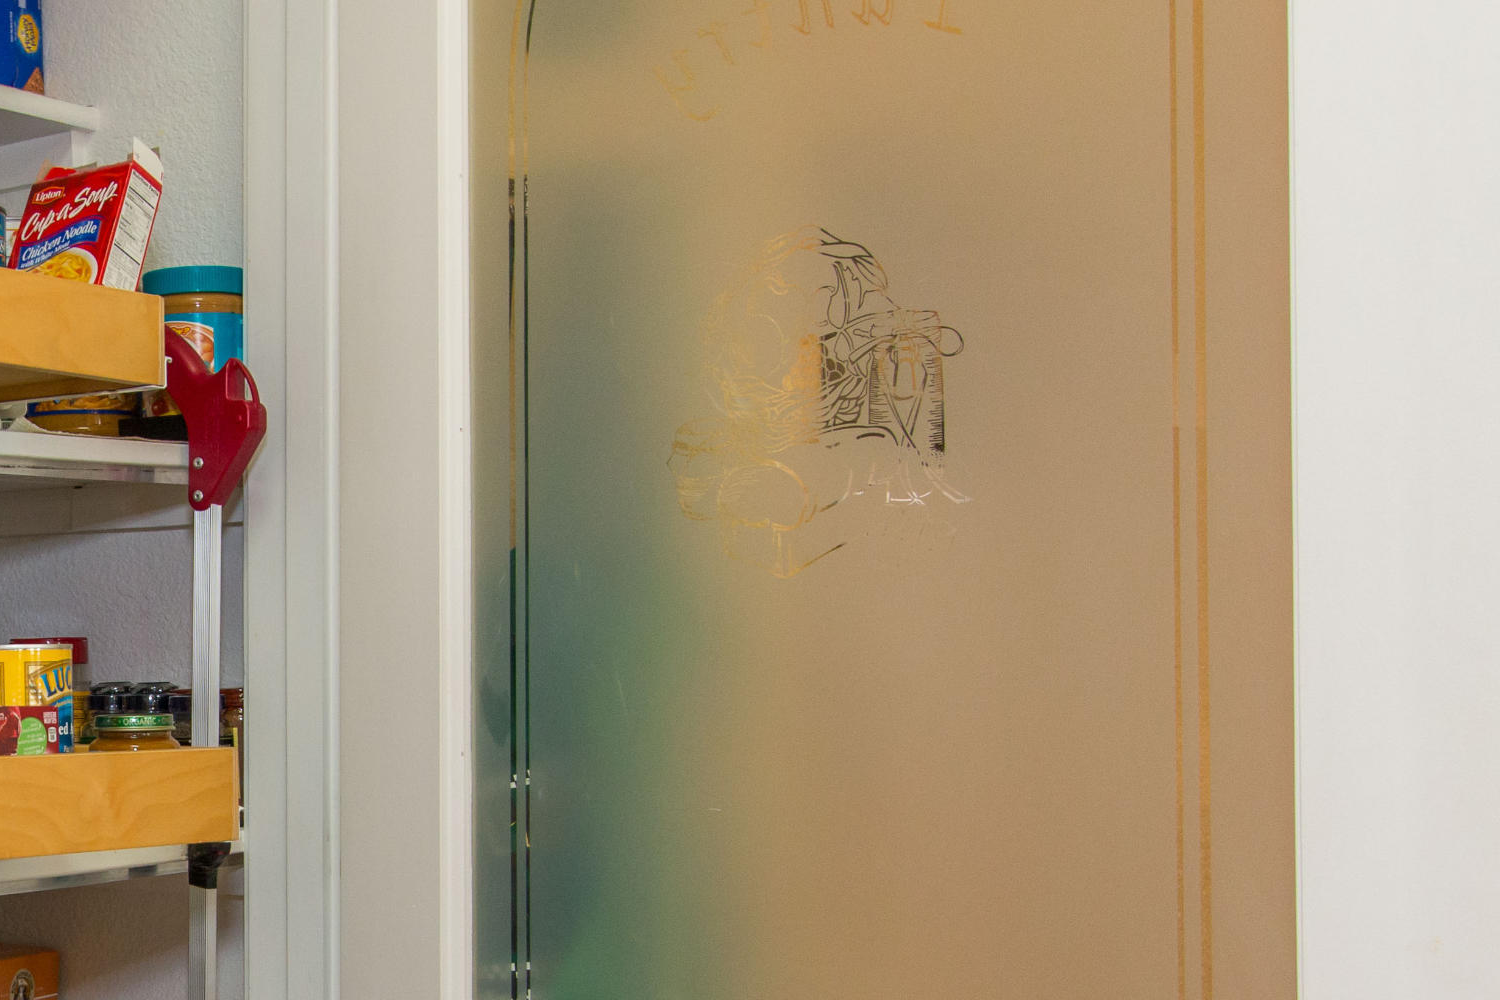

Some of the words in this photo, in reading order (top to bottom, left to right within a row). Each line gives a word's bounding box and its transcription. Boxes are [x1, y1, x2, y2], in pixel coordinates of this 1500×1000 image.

[35, 187, 62, 203] Lipton
[21, 236, 63, 262] Chicken
[61, 220, 98, 244] Noodle
[123, 715, 157, 726] ORGANIC
